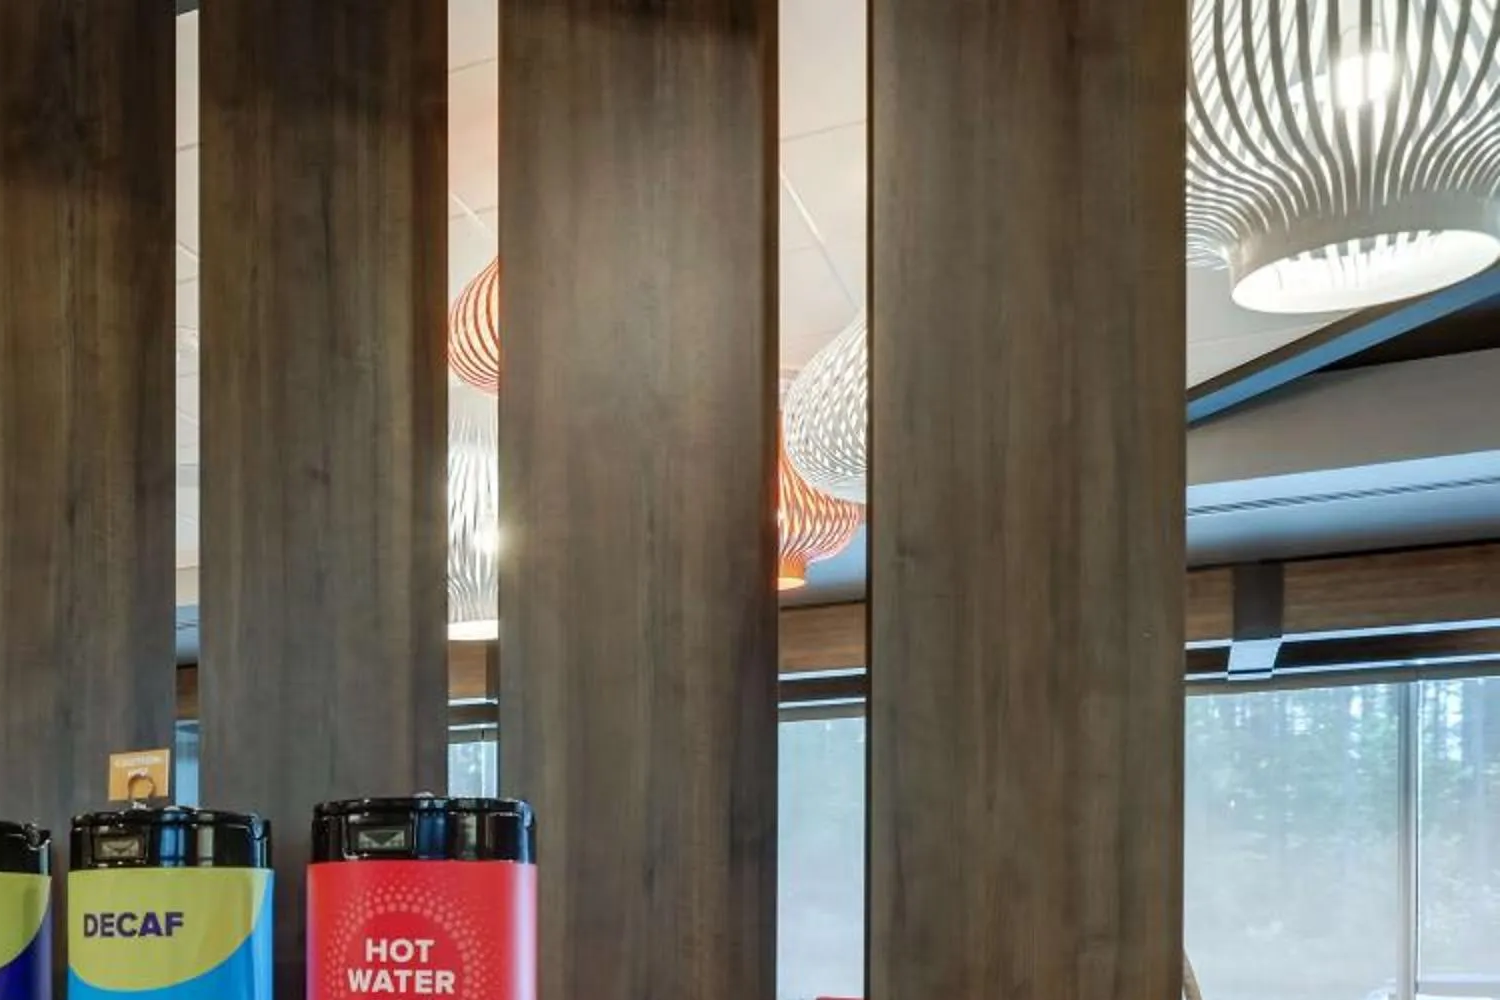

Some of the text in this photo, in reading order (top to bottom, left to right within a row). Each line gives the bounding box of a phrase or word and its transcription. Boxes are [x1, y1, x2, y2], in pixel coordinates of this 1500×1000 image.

[83, 911, 185, 938] DECAF
[364, 938, 435, 964] HOT
[347, 967, 456, 994] WATER
